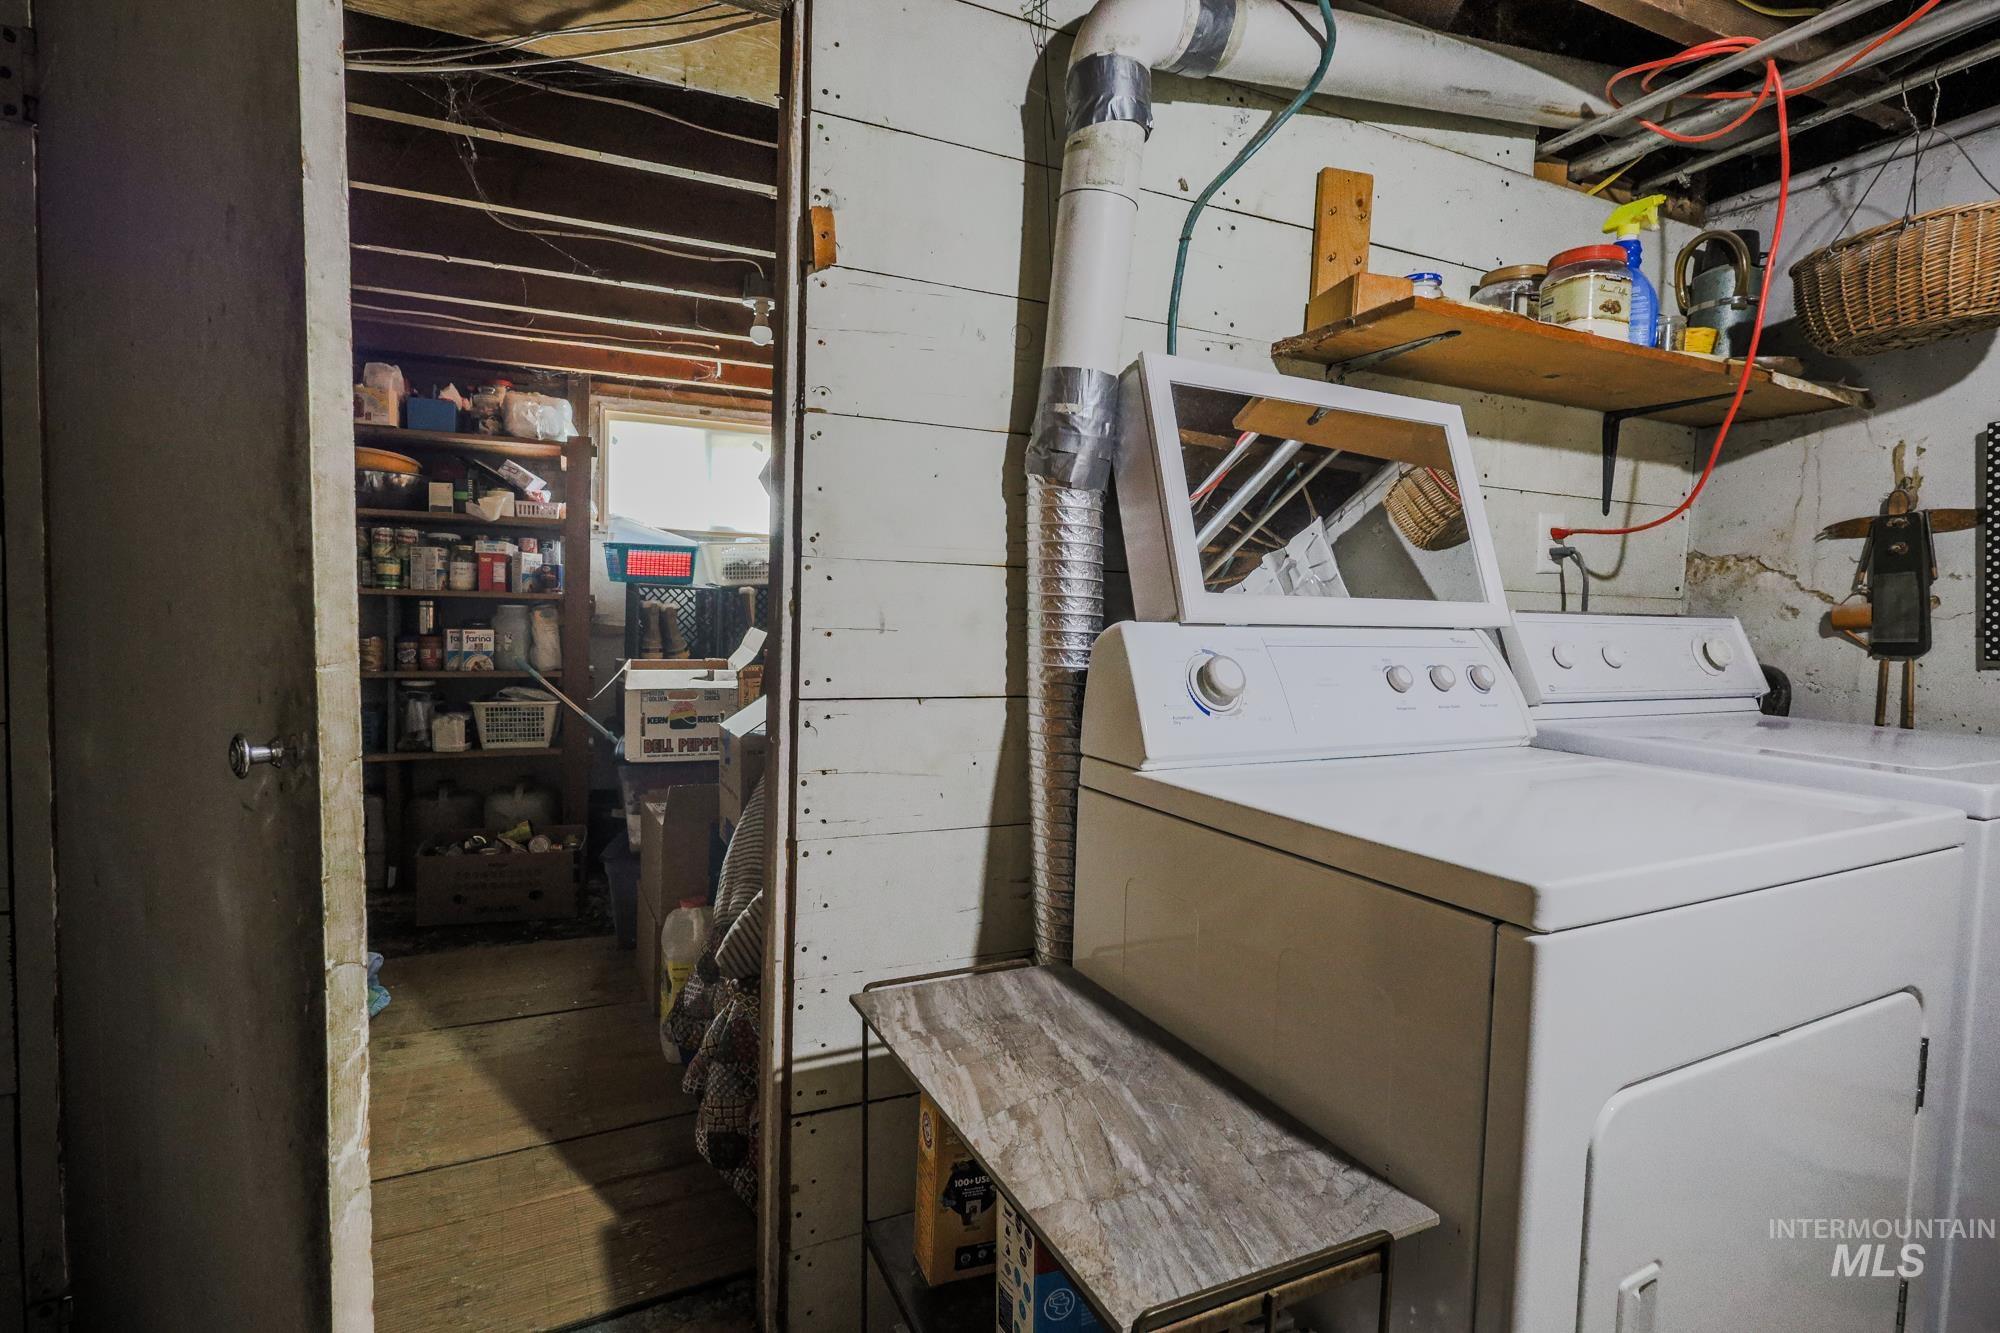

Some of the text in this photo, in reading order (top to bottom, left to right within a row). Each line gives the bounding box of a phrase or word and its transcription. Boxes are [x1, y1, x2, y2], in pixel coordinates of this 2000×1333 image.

[465, 635, 492, 644] farina
[647, 715, 720, 725] KERN RIDGE
[644, 738, 674, 753] BELL
[954, 1179, 974, 1188] 100+
